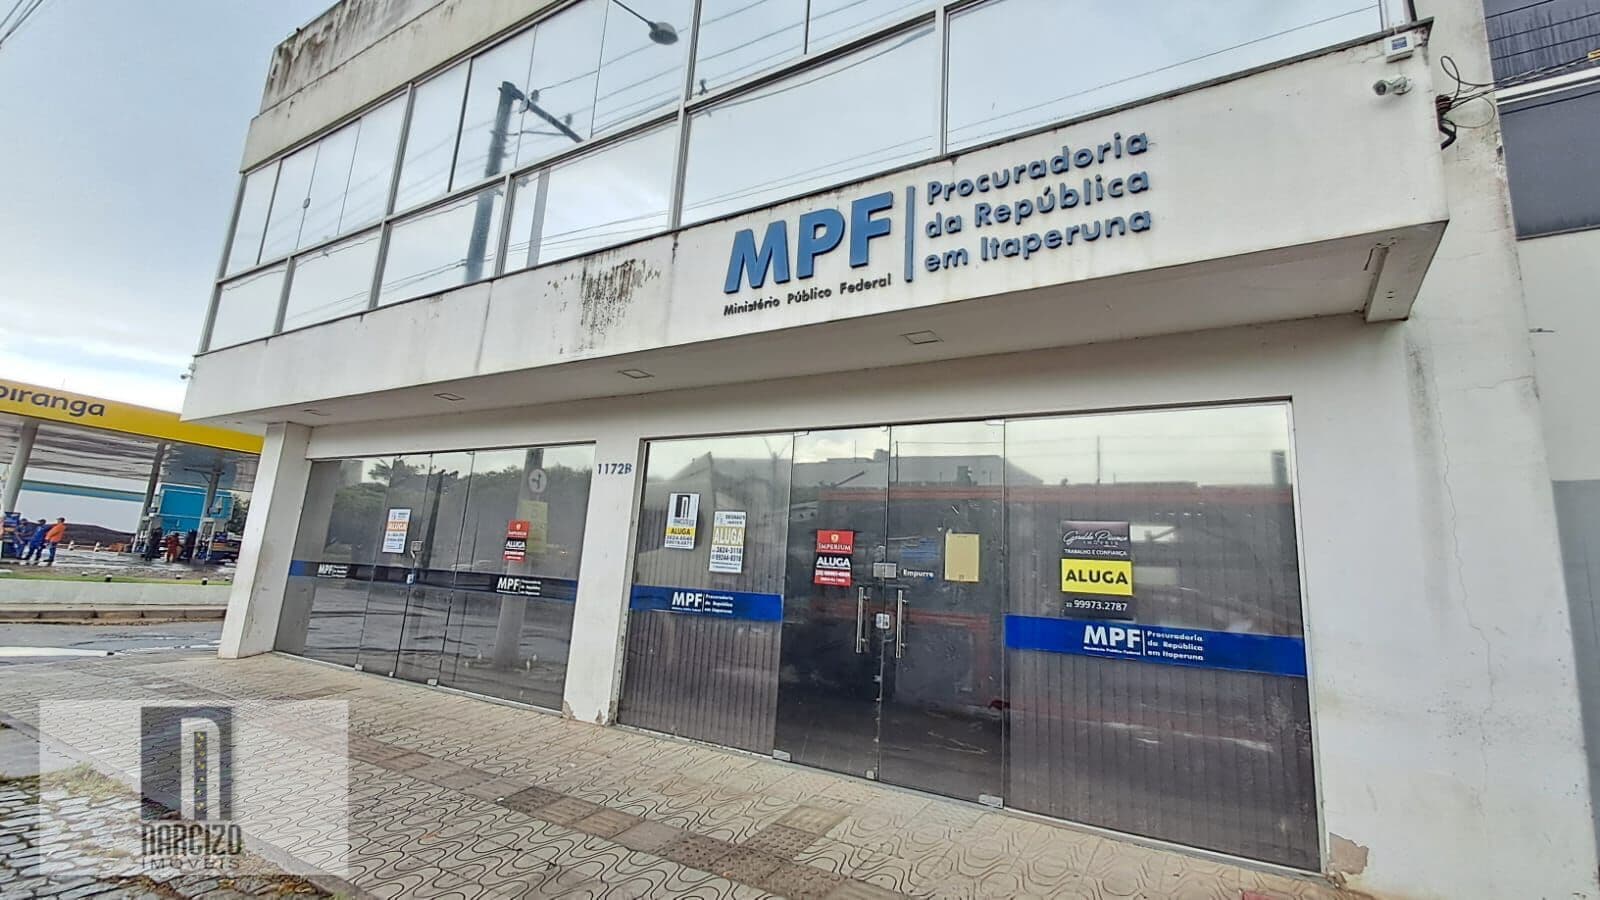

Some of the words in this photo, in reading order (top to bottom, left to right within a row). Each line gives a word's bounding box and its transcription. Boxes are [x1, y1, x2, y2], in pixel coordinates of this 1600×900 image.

[927, 132, 1148, 205] Procuradoria
[925, 212, 962, 238] da
[974, 170, 1149, 228] República
[724, 191, 893, 295] MPF
[924, 246, 968, 272] em
[980, 210, 1152, 261] Itaperuna
[723, 296, 781, 317] Ministério
[787, 286, 832, 306] Público
[839, 272, 892, 295] Federal
[598, 462, 632, 475] 1172B
[671, 527, 692, 535] ALUGA
[713, 527, 745, 545] ALUGA
[505, 540, 526, 549] ALUGA
[818, 542, 851, 551] IMPERIUM
[816, 556, 851, 568] ALUGA
[497, 576, 520, 591] MPF
[1065, 569, 1128, 585] ALUGA
[671, 591, 703, 607] MPF
[1074, 599, 1128, 612] 99973.2787
[1083, 624, 1141, 648] MPF
[1147, 630, 1204, 643] Procuradoria
[1147, 639, 1159, 647] da
[1162, 638, 1204, 652] República
[1162, 649, 1205, 661] Itaperuna
